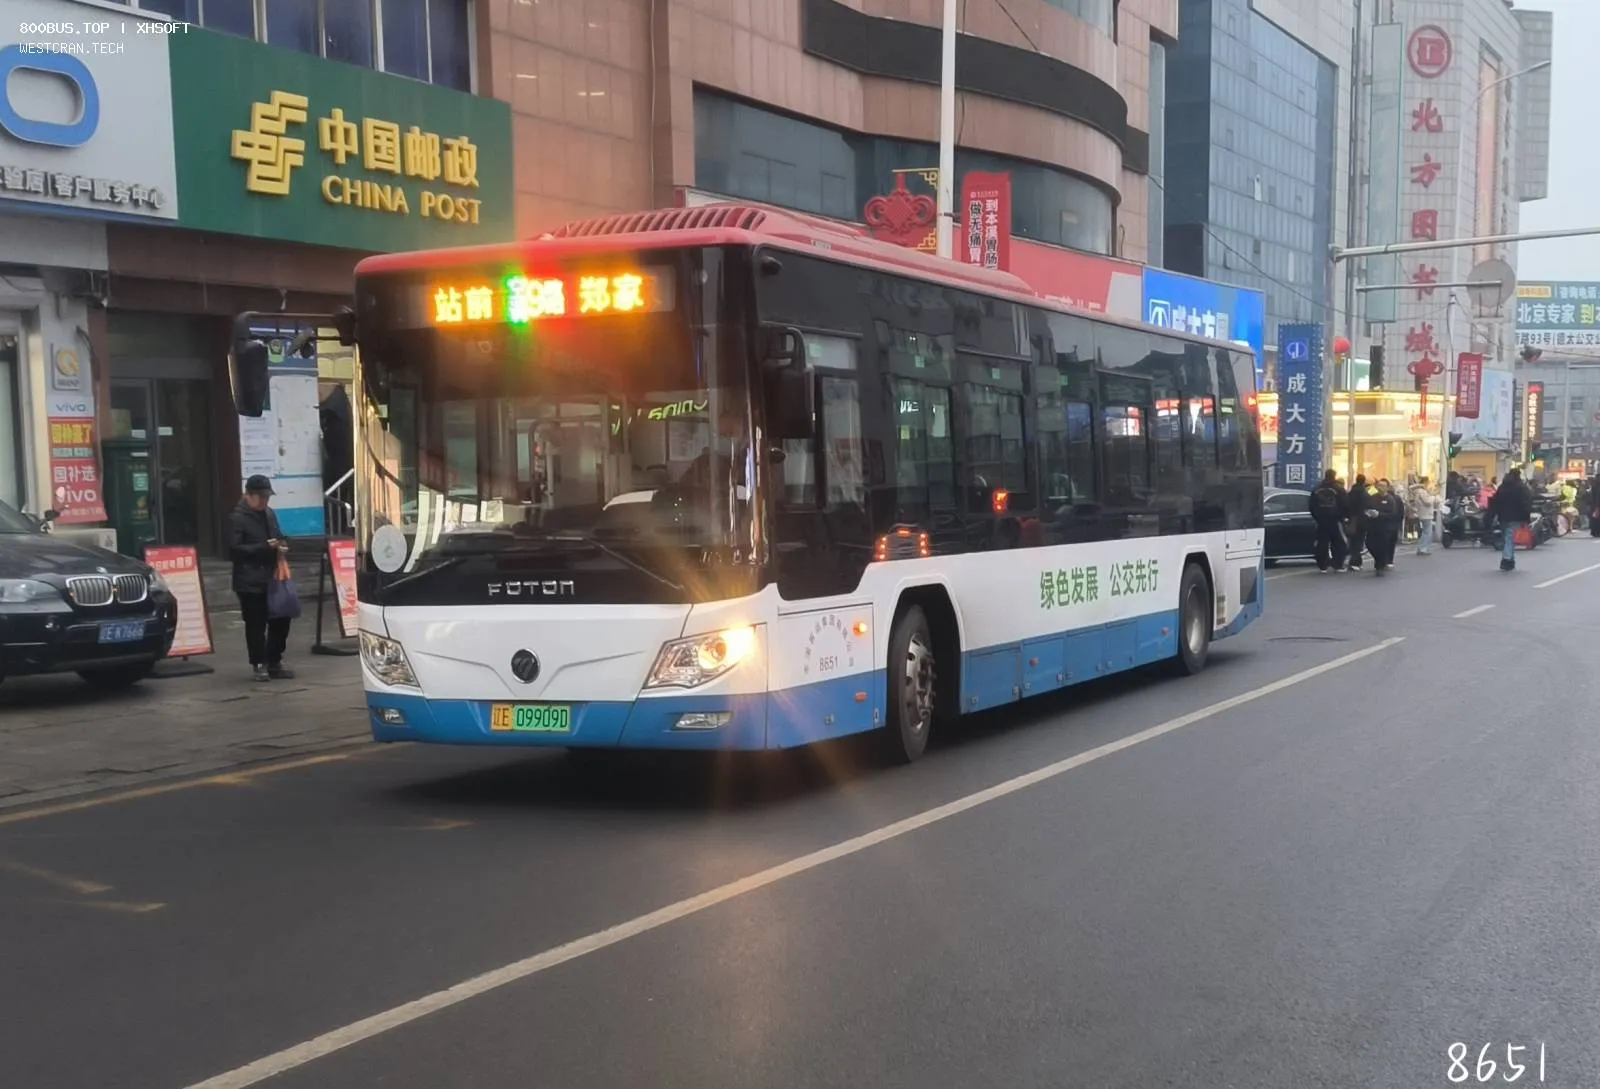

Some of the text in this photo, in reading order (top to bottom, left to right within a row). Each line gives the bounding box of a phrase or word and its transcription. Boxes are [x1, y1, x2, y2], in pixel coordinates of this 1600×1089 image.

[318, 108, 480, 188] 中国邮政
[321, 175, 482, 224] CHINA POST
[1518, 303, 1575, 324] 北京专家
[1285, 373, 1306, 484] 成大方圆
[488, 580, 574, 595] FOTON
[1040, 559, 1158, 609] 绿色发展 公交先行
[819, 655, 838, 672] 8651
[516, 707, 568, 728] 09909D
